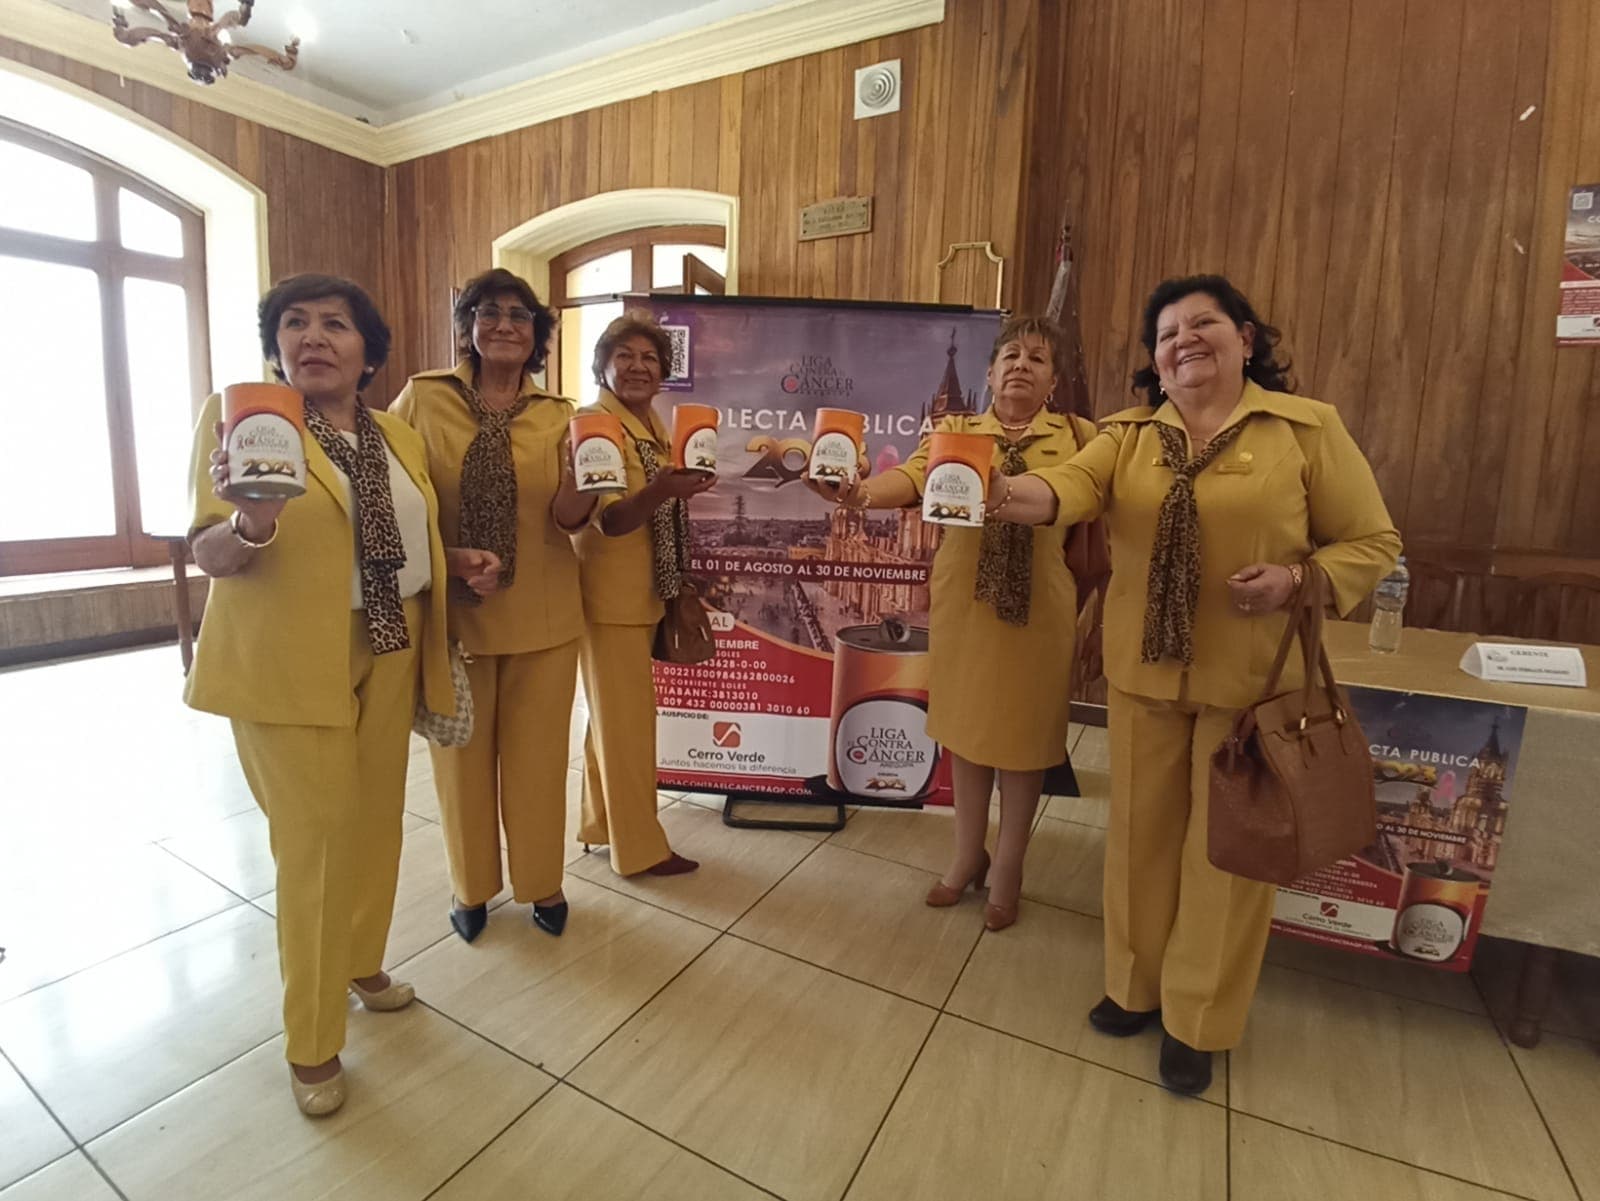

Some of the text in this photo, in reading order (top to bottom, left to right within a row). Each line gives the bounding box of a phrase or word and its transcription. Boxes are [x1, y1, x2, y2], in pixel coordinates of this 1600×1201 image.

[717, 408, 807, 431] LECTA
[691, 559, 927, 581] EL 01 DE AGOSTO AL 30 DE NOVIEMBRE
[715, 639, 760, 650] IEMBRE
[671, 678, 717, 688] CORRIENTE
[721, 682, 746, 690] SOLES
[663, 697, 810, 714] 009 432 00000381 3010 60
[661, 710, 696, 719] AUSPICIO
[871, 727, 907, 740] LIGA
[857, 736, 913, 749] CONTRA
[688, 748, 766, 763] Cerro Verde
[1410, 749, 1480, 769] PUBLICA
[661, 758, 797, 774] Juntos hacemos la diferencia
